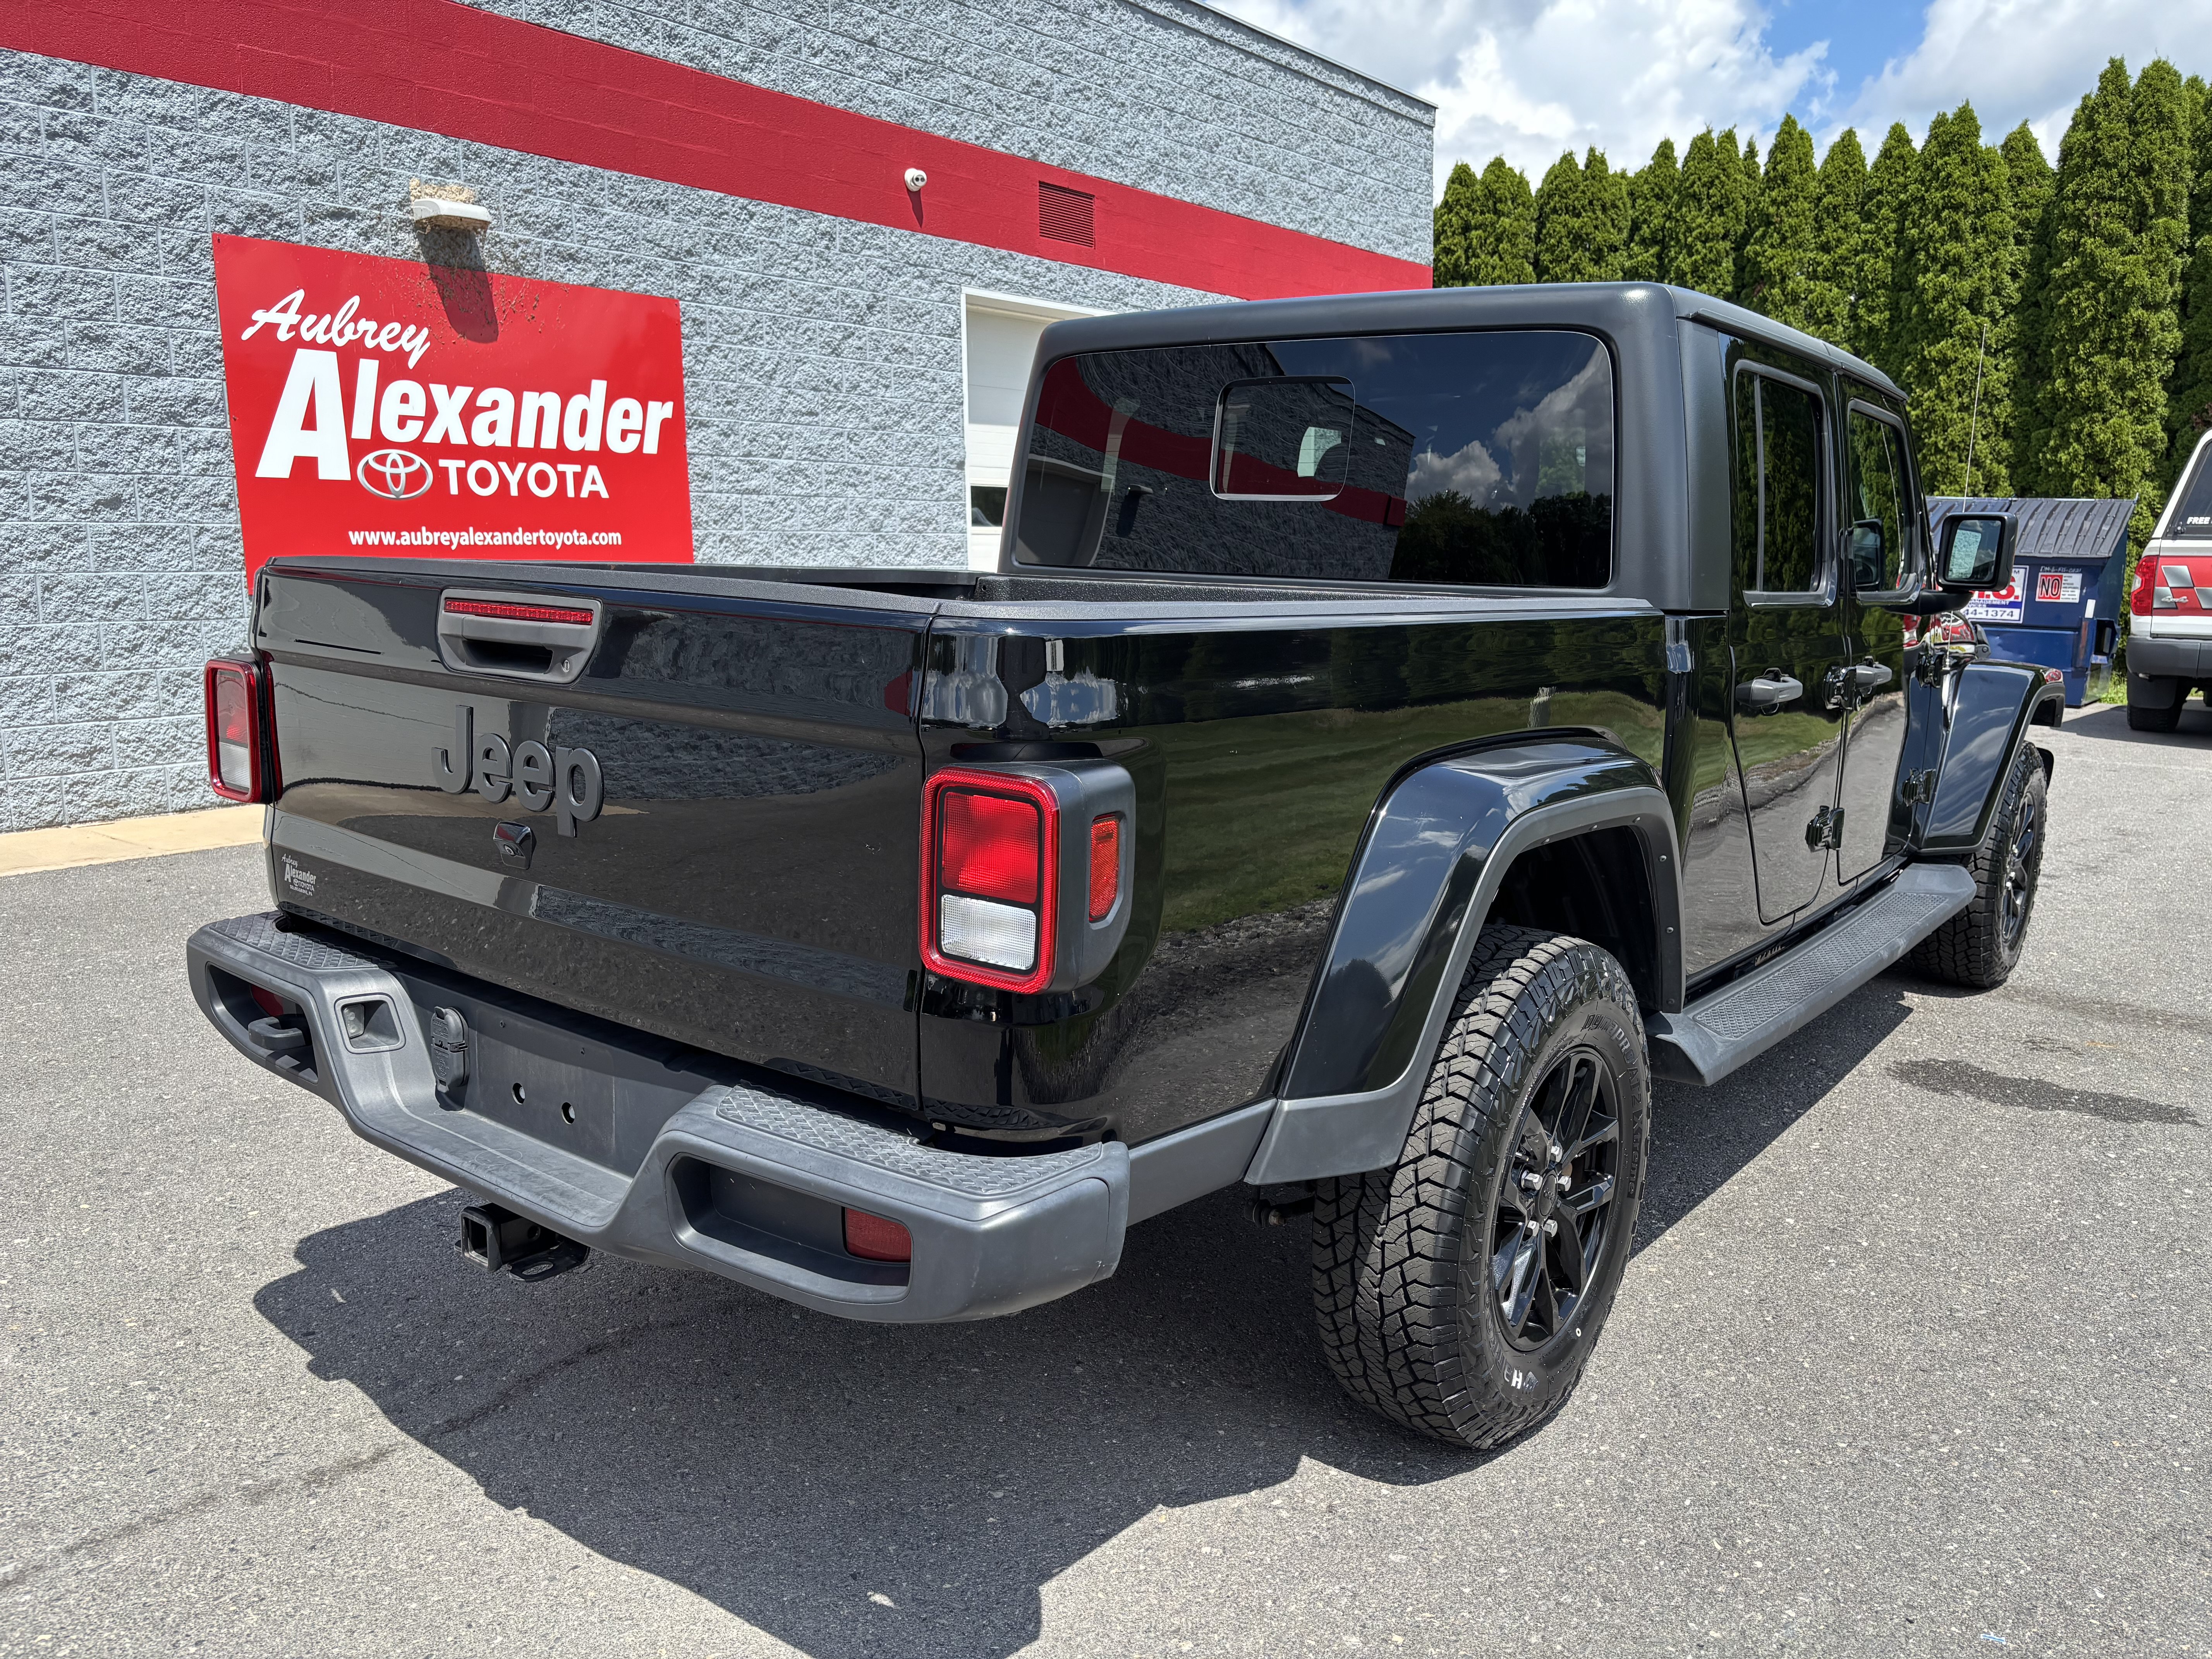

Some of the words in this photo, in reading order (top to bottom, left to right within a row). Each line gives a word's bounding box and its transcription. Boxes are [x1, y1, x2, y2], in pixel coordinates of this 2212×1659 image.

[241, 289, 431, 369] Aubrey
[254, 348, 673, 481] Alexander
[438, 459, 610, 499] TOYOTA
[2186, 517, 2210, 525] FREE
[349, 526, 622, 550] www.aubreyalexandertoyota.com
[2039, 577, 2061, 597] NO
[1963, 609, 2014, 618] 44-1374
[431, 705, 604, 838] Jeep
[282, 854, 298, 868] Aubrey
[285, 863, 316, 884] Alexander
[299, 881, 314, 892] TOYOTA
